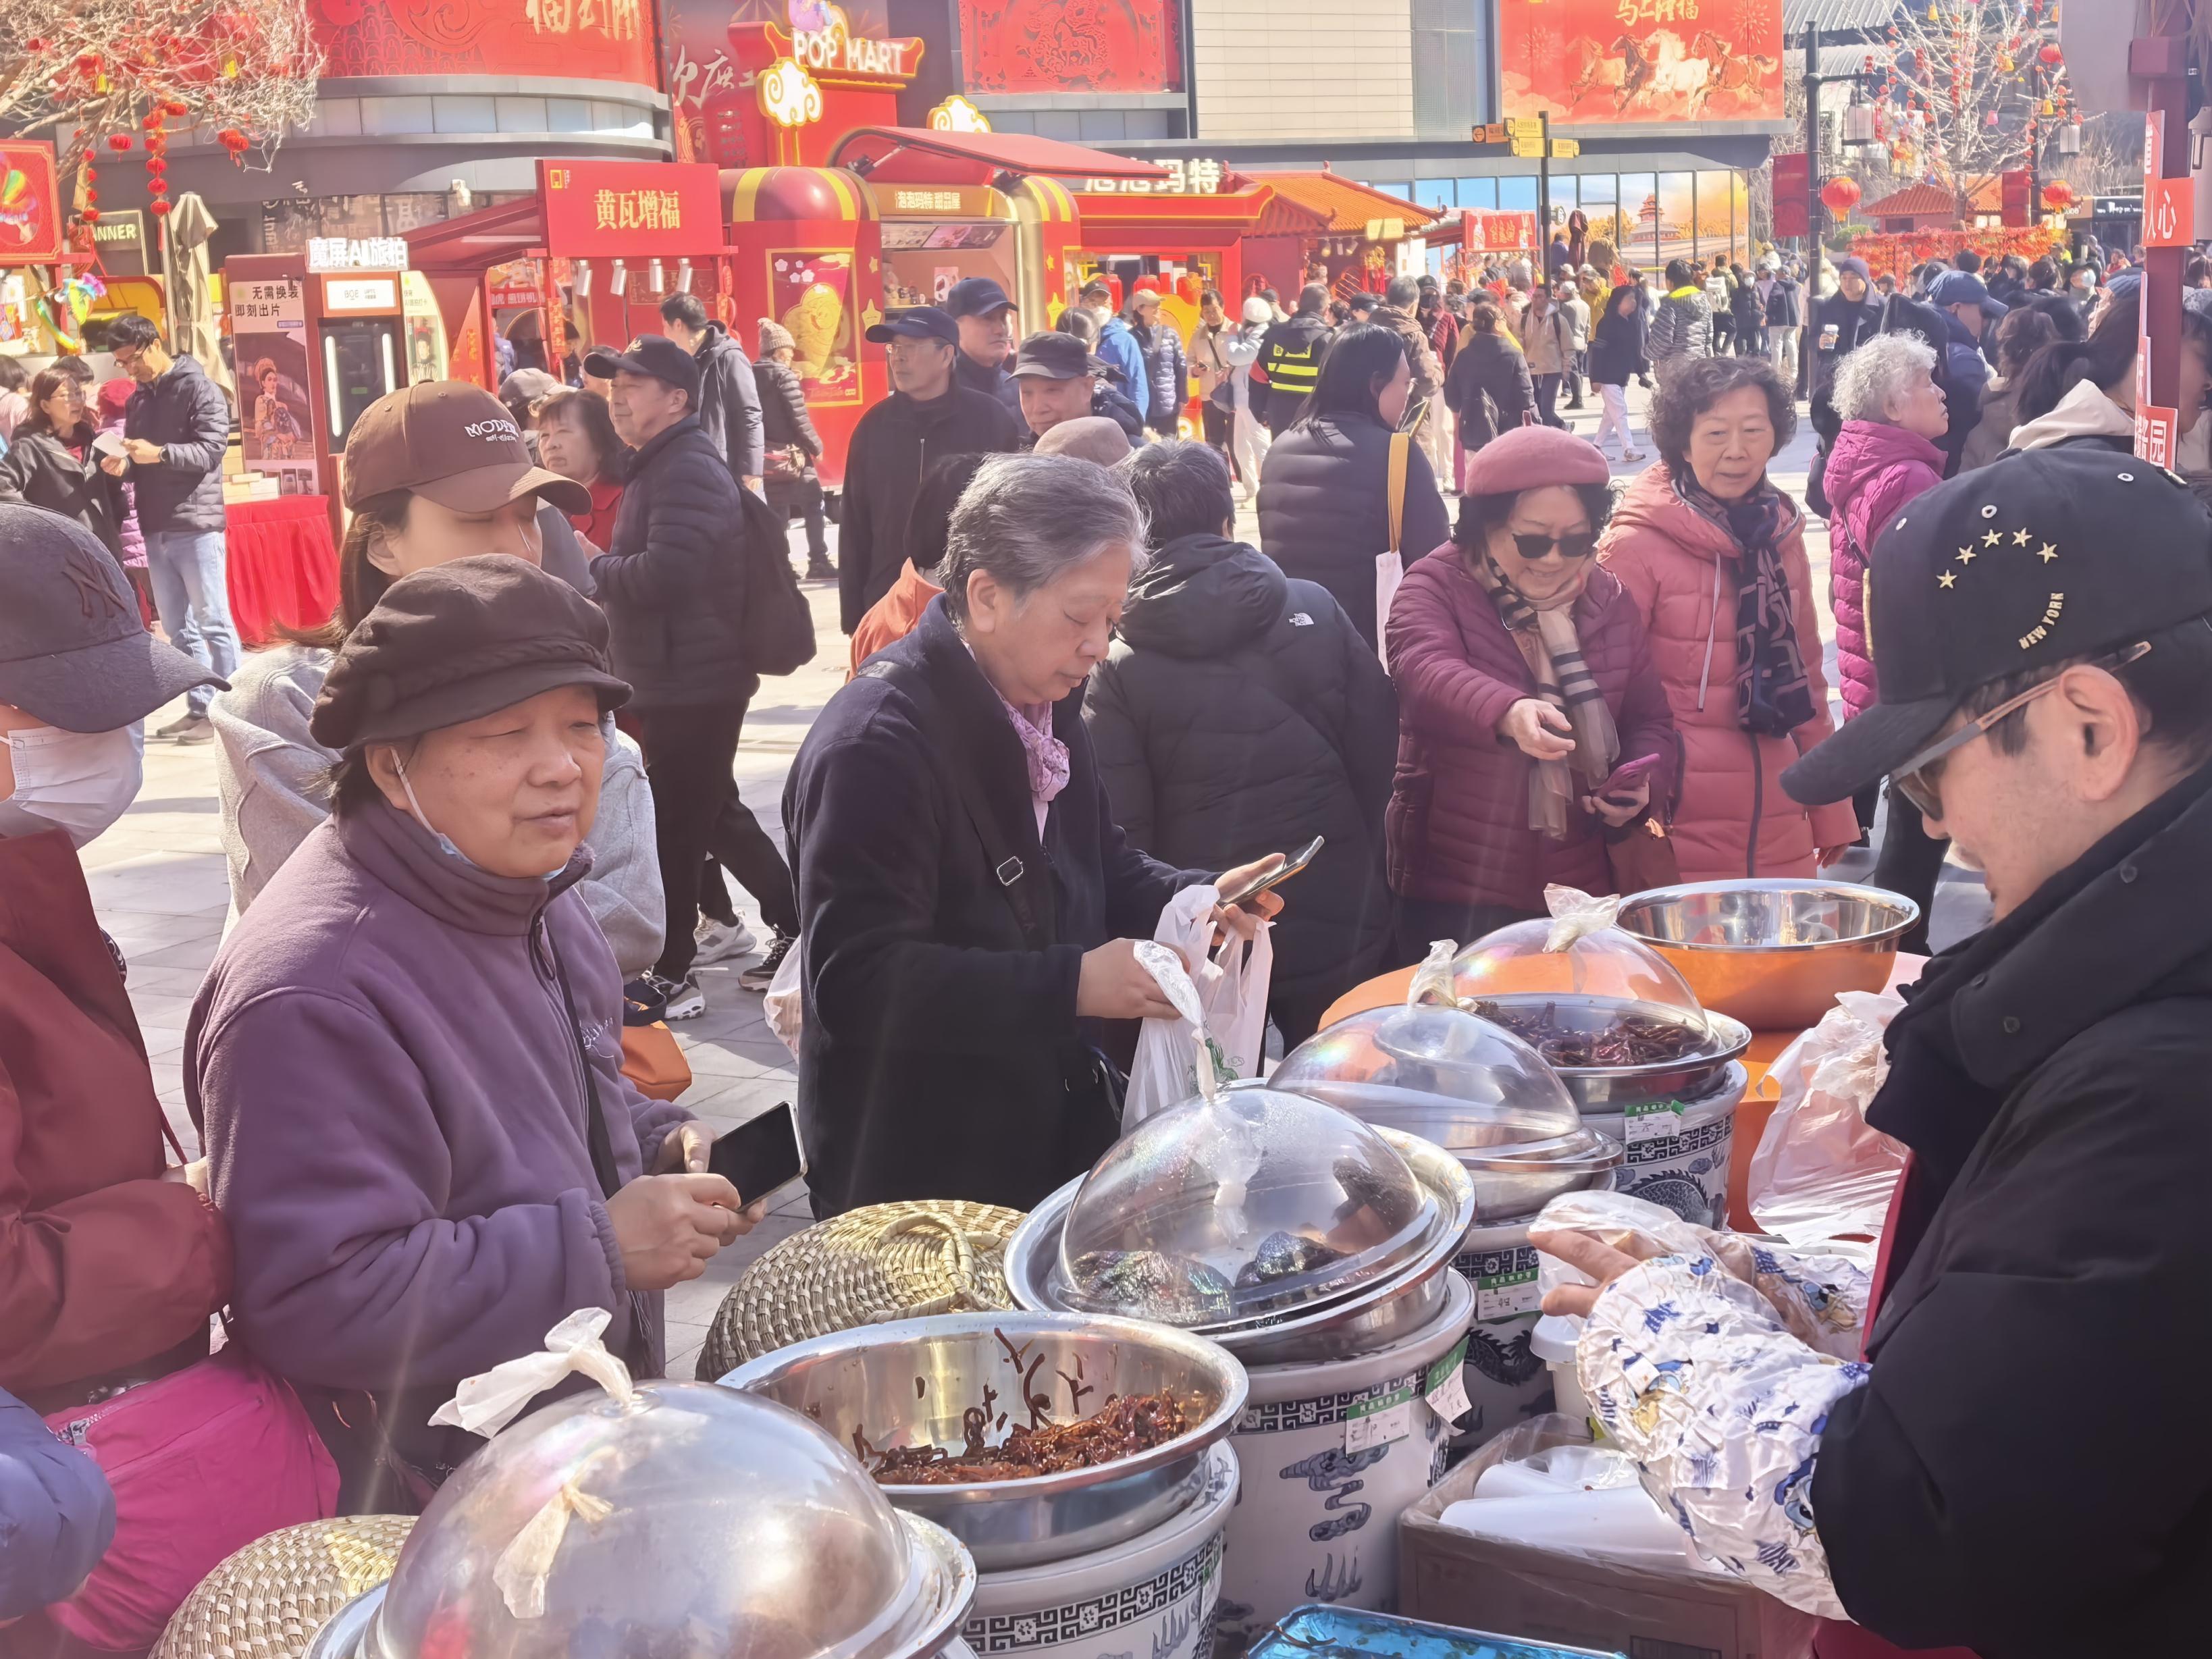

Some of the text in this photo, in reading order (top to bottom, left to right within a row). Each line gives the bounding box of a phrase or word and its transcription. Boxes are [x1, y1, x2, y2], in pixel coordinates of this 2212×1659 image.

[792, 28, 903, 74] POP MART
[594, 190, 681, 230] 黄瓦增福
[252, 285, 300, 300] 无需换装
[344, 290, 359, 298] BOE
[234, 303, 281, 317] 即刻出片
[2018, 592, 2064, 650] NEW YORK
